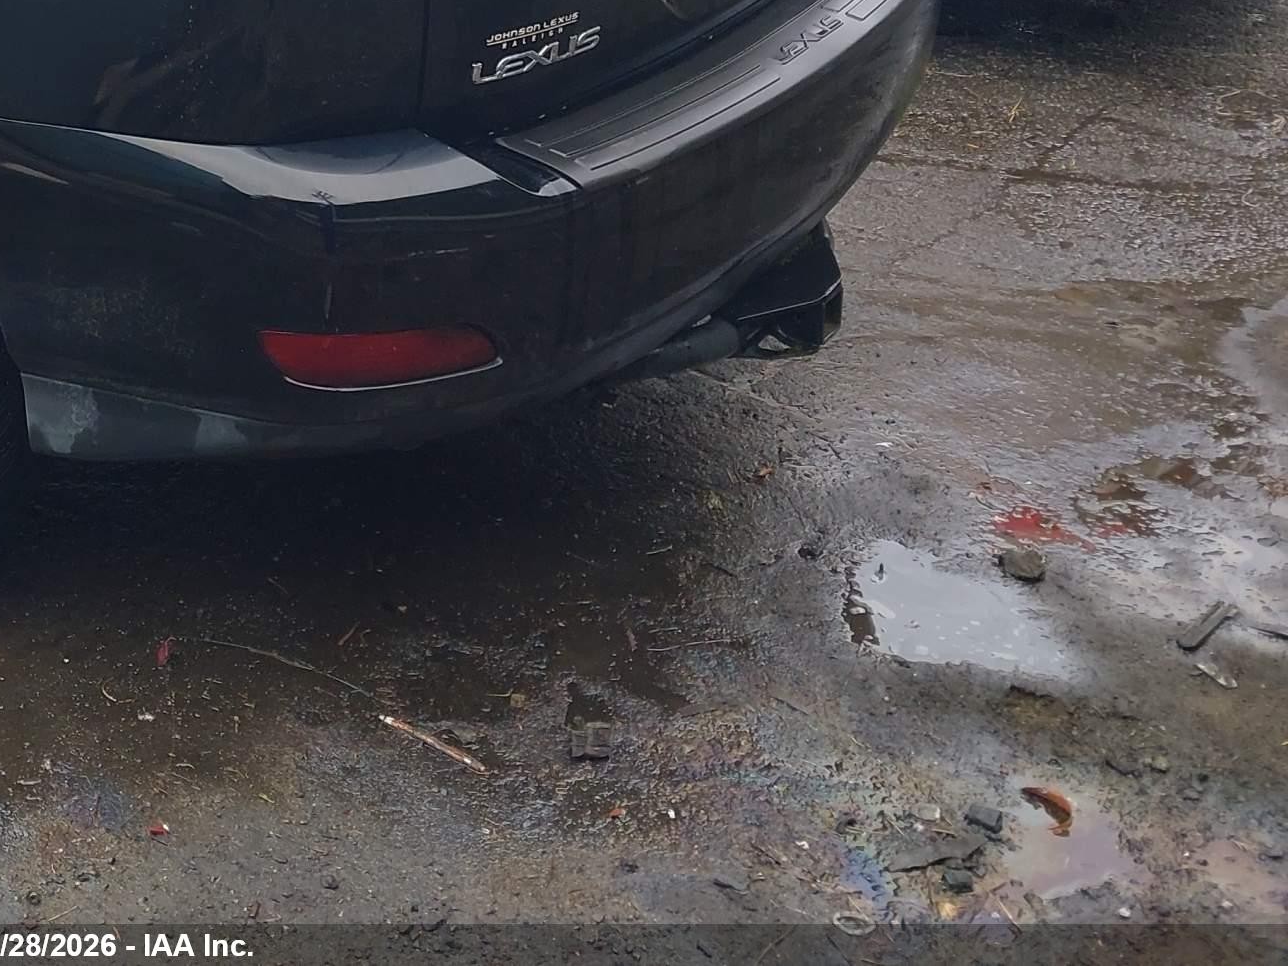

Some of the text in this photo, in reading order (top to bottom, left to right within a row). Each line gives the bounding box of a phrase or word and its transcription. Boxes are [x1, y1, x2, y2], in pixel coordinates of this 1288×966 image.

[486, 11, 580, 43] JOHNSON LEXUS
[471, 25, 601, 85] LEXUS
